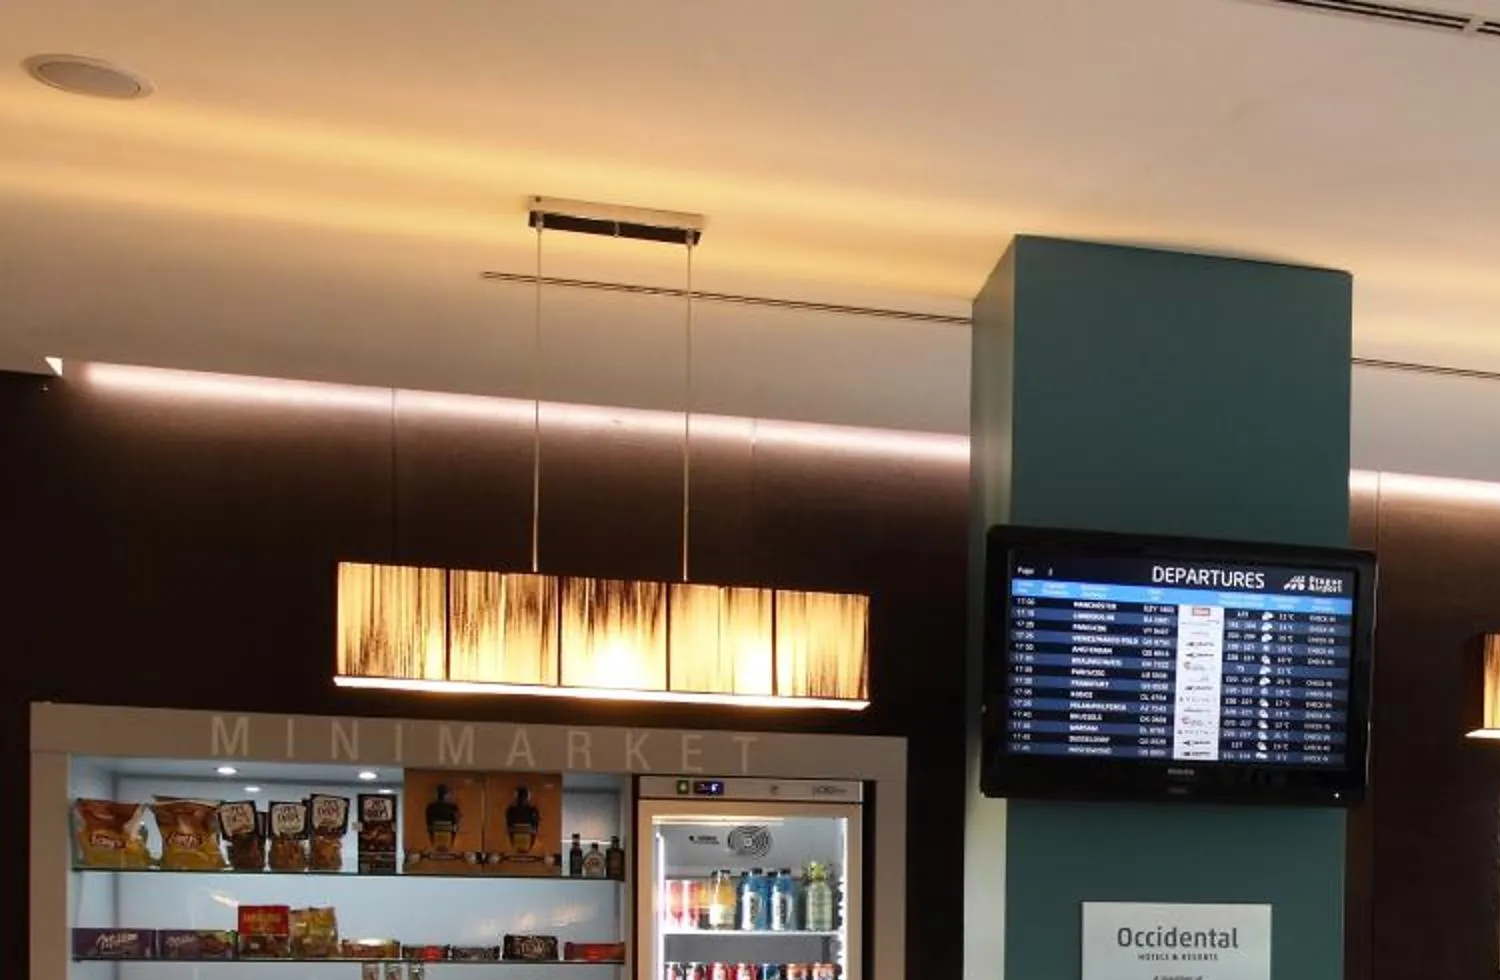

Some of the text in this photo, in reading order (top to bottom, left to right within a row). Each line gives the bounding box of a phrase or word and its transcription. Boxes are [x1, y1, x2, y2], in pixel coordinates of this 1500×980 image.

[1152, 565, 1265, 590] DEPARTURES
[210, 715, 759, 772] MINIMARKET
[1117, 925, 1239, 949] Occidental
[1138, 953, 1169, 961] HOTELS
[1182, 953, 1218, 962] RESORTS
